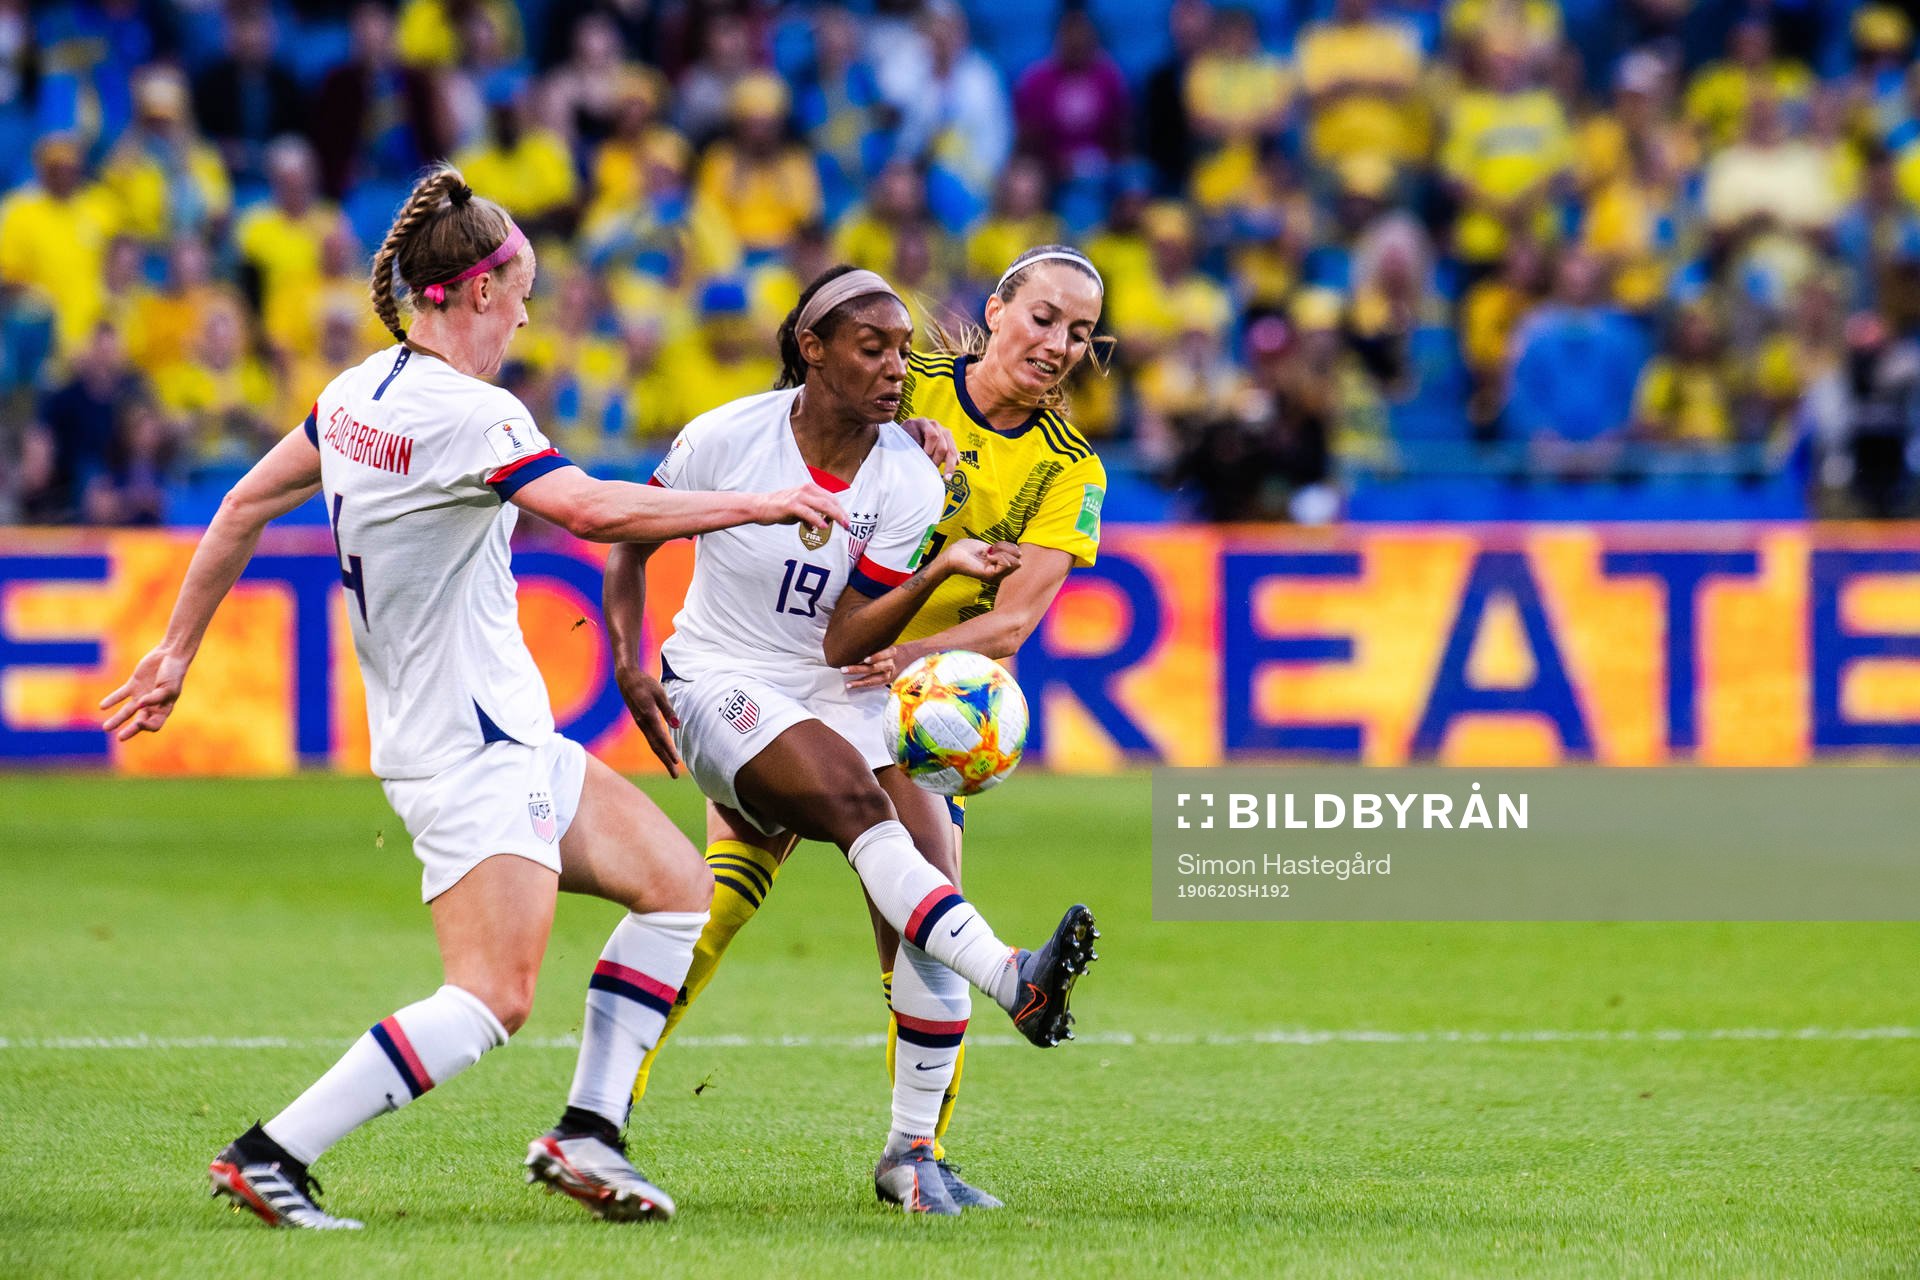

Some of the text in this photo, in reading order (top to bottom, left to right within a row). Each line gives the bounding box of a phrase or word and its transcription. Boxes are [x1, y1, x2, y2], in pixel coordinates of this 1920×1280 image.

[324, 406, 414, 476] SAUERBRUNN
[333, 493, 370, 633] 4
[776, 558, 831, 618] 19
[1016, 552, 1920, 758] REATE
[725, 694, 746, 721] USA
